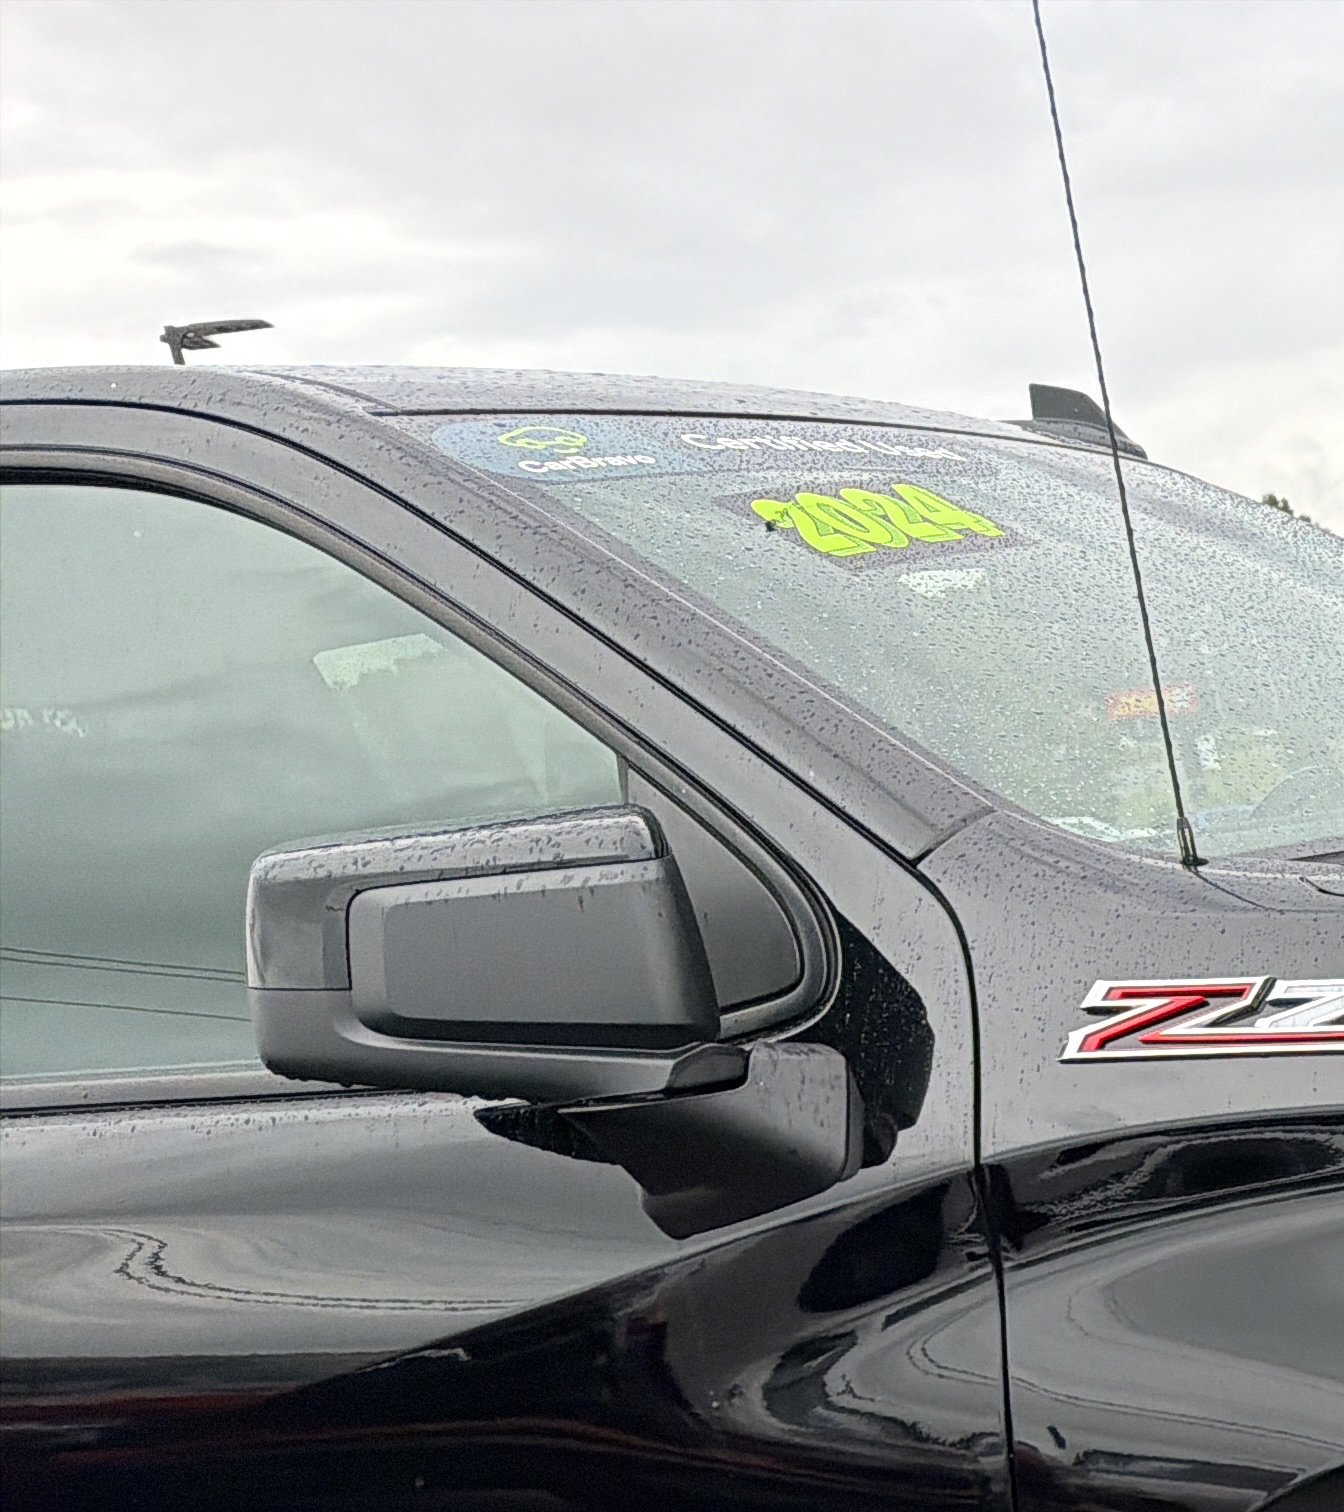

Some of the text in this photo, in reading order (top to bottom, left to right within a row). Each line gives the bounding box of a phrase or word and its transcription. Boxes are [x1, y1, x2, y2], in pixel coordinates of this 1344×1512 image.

[681, 433, 967, 462] Certified Used
[518, 452, 656, 475] CarBravo
[749, 482, 1005, 558] 2024
